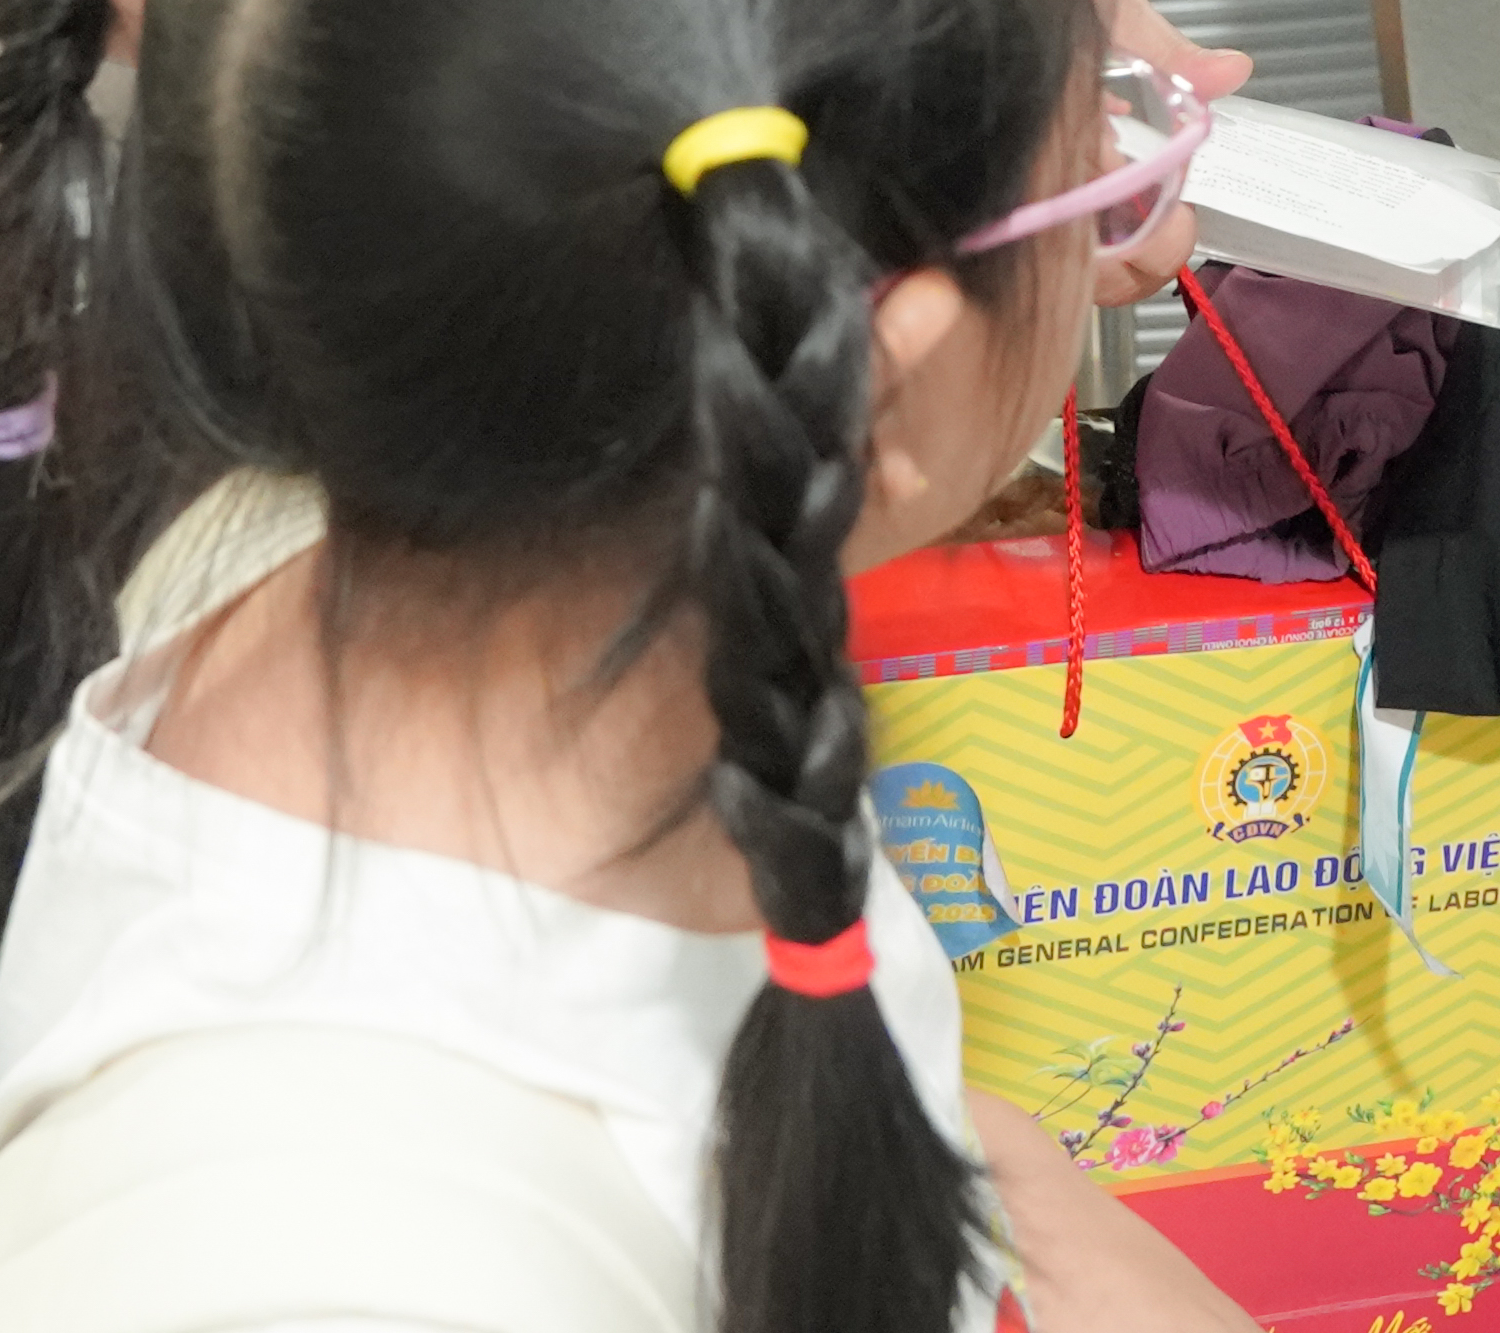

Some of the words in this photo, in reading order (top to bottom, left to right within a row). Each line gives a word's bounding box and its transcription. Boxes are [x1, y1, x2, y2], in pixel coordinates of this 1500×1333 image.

[886, 836, 950, 864] YẾN
[1093, 868, 1210, 916] ĐOÀN
[1224, 861, 1299, 900] LAO
[1313, 845, 1427, 891] ĐỘG
[927, 902, 998, 923] 2025
[997, 934, 1130, 968] GENERAL
[1140, 901, 1374, 950] CONFEDERATION
